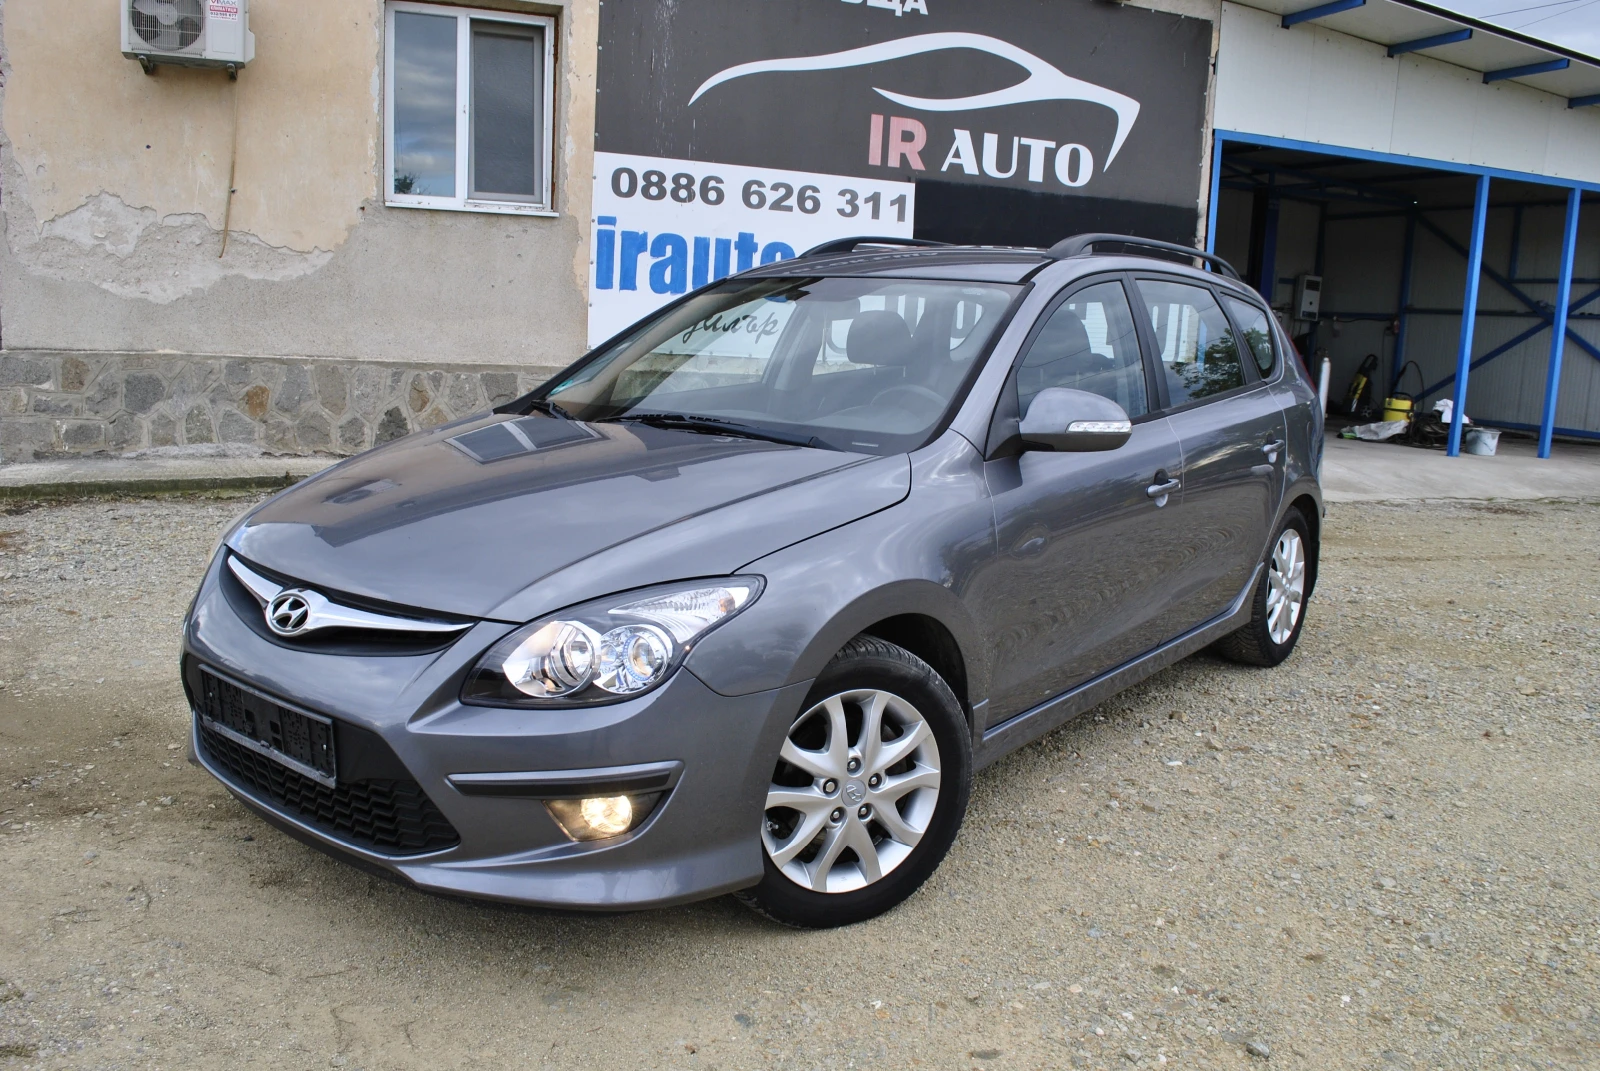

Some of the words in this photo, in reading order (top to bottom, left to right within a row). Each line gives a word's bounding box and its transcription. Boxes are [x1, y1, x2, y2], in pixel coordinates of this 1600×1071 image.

[868, 114, 927, 171] IR
[940, 128, 1094, 188] AUTO
[611, 167, 725, 206] 0886
[741, 179, 821, 214] 626
[836, 188, 907, 222] 311
